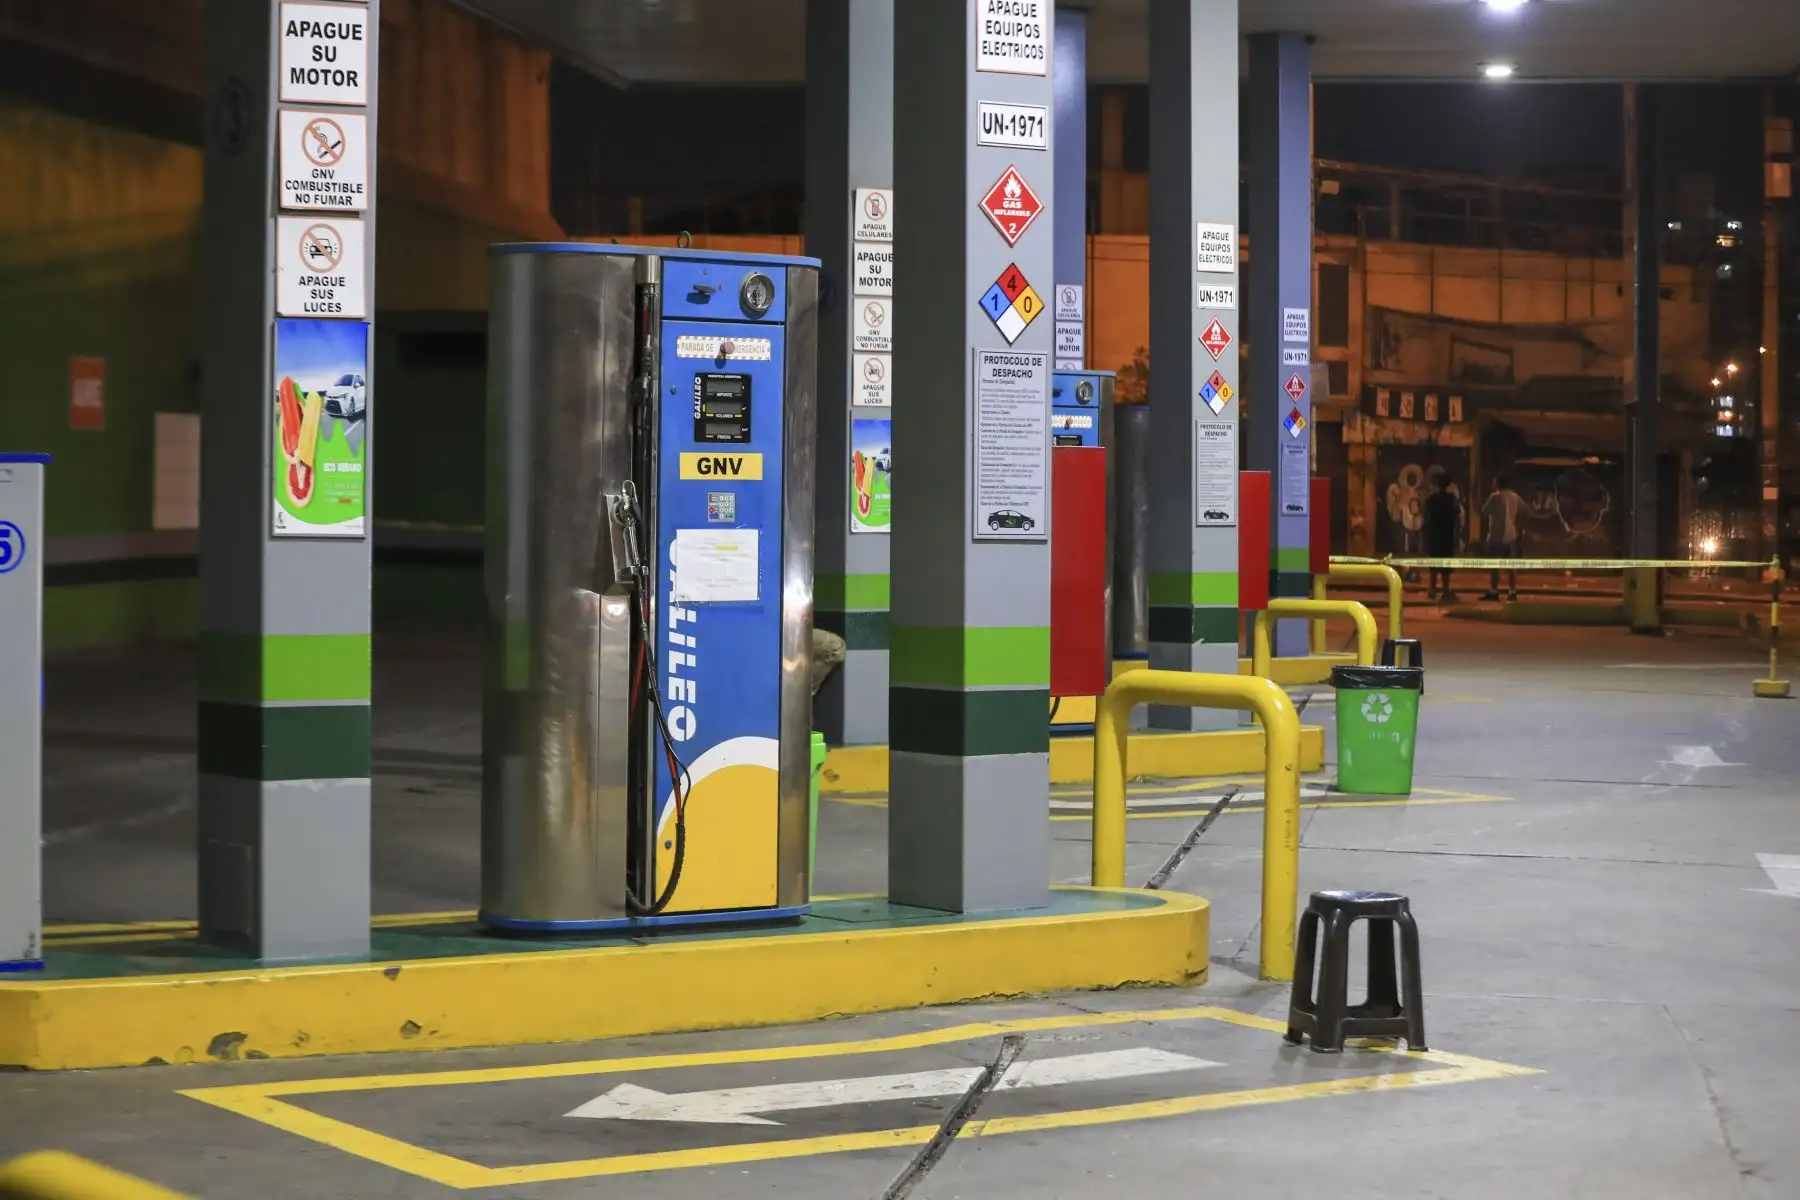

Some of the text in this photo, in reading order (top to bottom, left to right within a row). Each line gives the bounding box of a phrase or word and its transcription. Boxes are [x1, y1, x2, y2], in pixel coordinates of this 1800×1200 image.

[988, 0, 1037, 18] APAGUE
[286, 20, 363, 41] APAGUE
[986, 20, 1040, 39] EQUIPOS
[311, 45, 337, 62] SU
[982, 40, 1044, 60] ELECTRICOS
[290, 67, 358, 87] MOTOR
[983, 112, 1043, 138] UN-1971
[311, 168, 335, 180] GNV
[285, 180, 363, 194] COMBUSTIBLE
[295, 193, 353, 206] NO FUMAR
[1003, 201, 1022, 209] GAS
[862, 223, 887, 231] APAGUE
[1009, 223, 1017, 234] 2
[1202, 232, 1229, 241] APAGUE
[1201, 243, 1231, 252] EQUIPOS
[857, 252, 893, 262] APAGUE
[1199, 254, 1232, 264] ELECTRICOS
[869, 265, 882, 274] SU
[298, 276, 346, 287] APAGUE
[859, 277, 892, 287] MOTOR
[1007, 274, 1017, 292] 4
[310, 288, 334, 300] SUS
[1199, 290, 1233, 303] UN-1971
[303, 302, 342, 313] LUCES
[992, 293, 1032, 313] 1 0
[1057, 327, 1081, 336] APAGUE
[682, 342, 704, 352] PARADA
[706, 343, 714, 352] DE
[1058, 344, 1080, 352] MOTOR
[984, 356, 1042, 366] PROTOCOLO DE
[1284, 352, 1307, 361] UN-1971
[992, 368, 1033, 379] DESPACHO
[1213, 377, 1219, 386] 4
[694, 377, 702, 419] GALILEO
[1206, 388, 1228, 397] 1 0
[697, 457, 743, 475] GNV
[668, 540, 696, 741] LILEO
